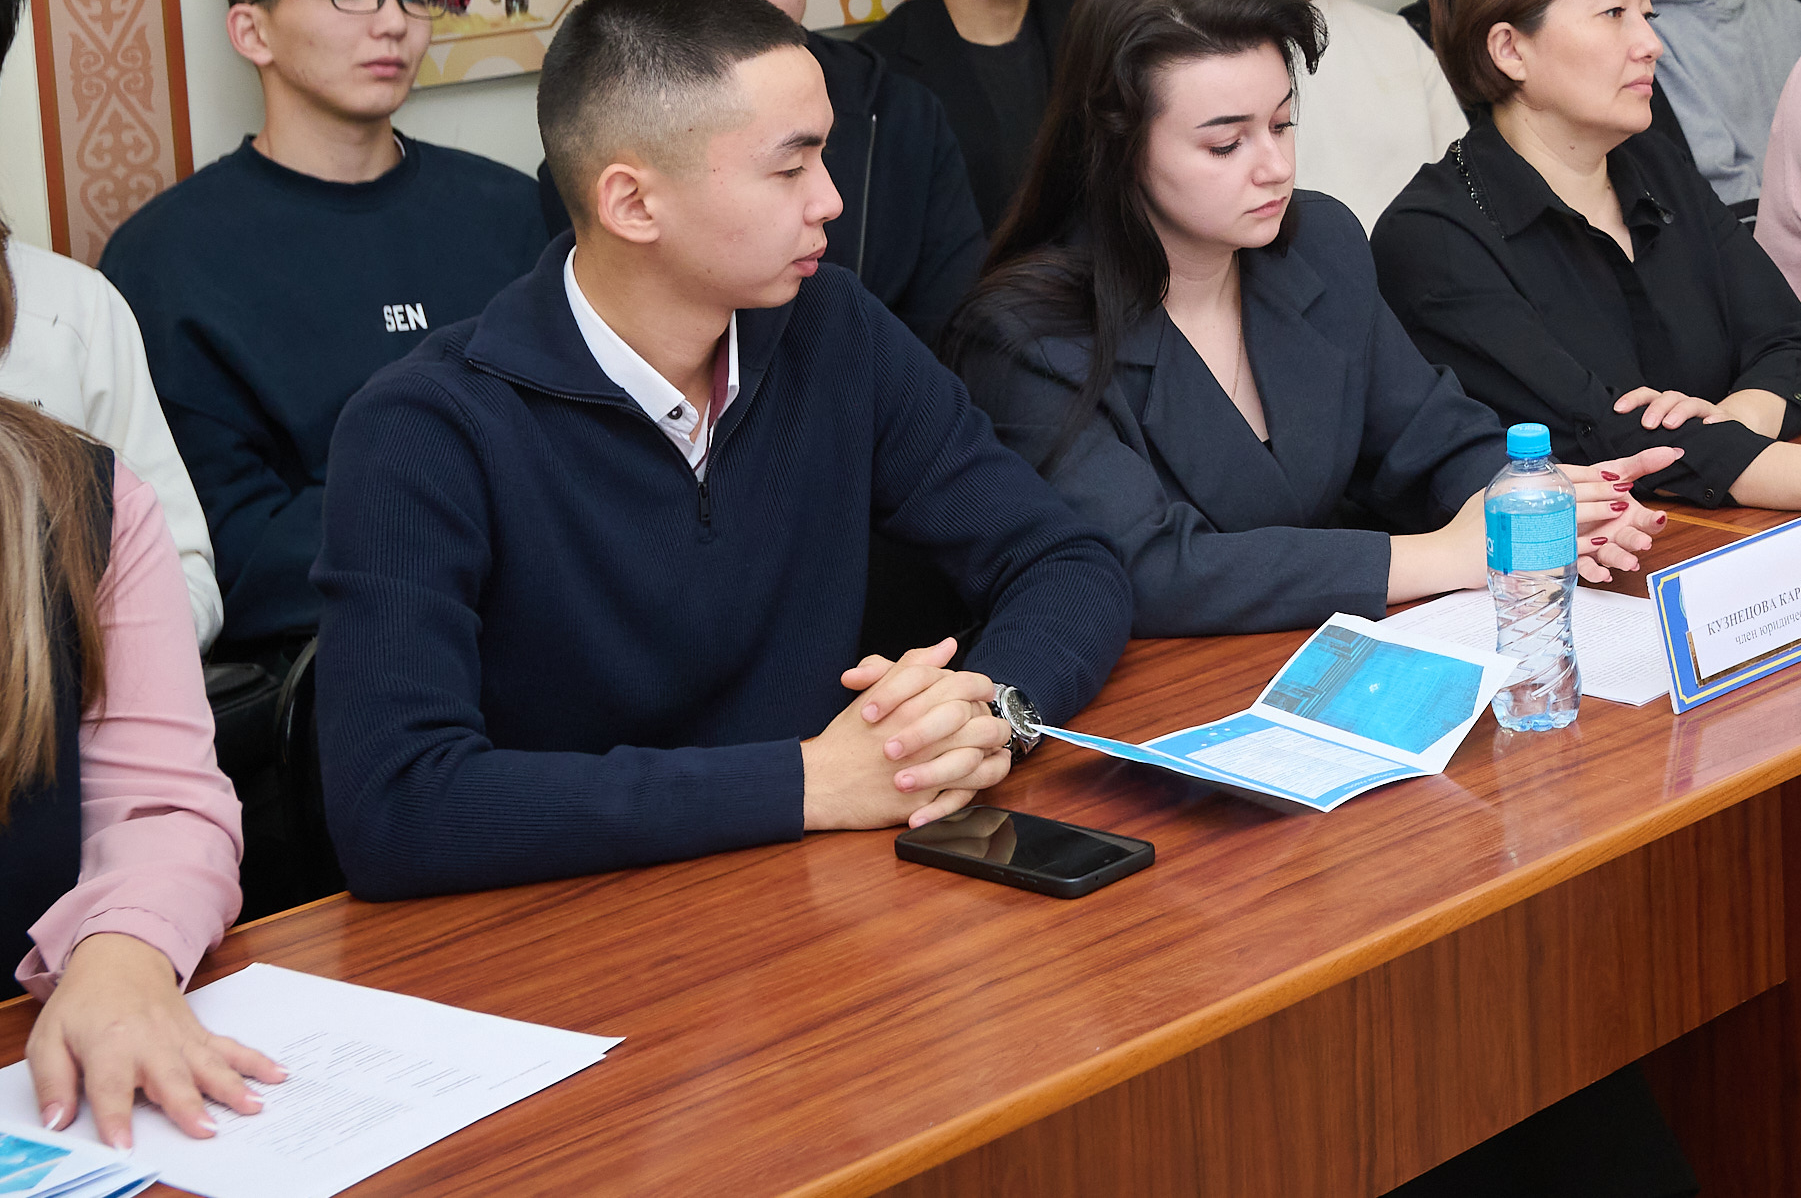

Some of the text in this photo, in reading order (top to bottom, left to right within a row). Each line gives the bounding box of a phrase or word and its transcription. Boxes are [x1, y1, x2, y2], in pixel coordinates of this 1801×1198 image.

[383, 302, 428, 333] SEN
[1706, 598, 1777, 636] КУЗНЕЦОВА
[1735, 629, 1758, 645] член
